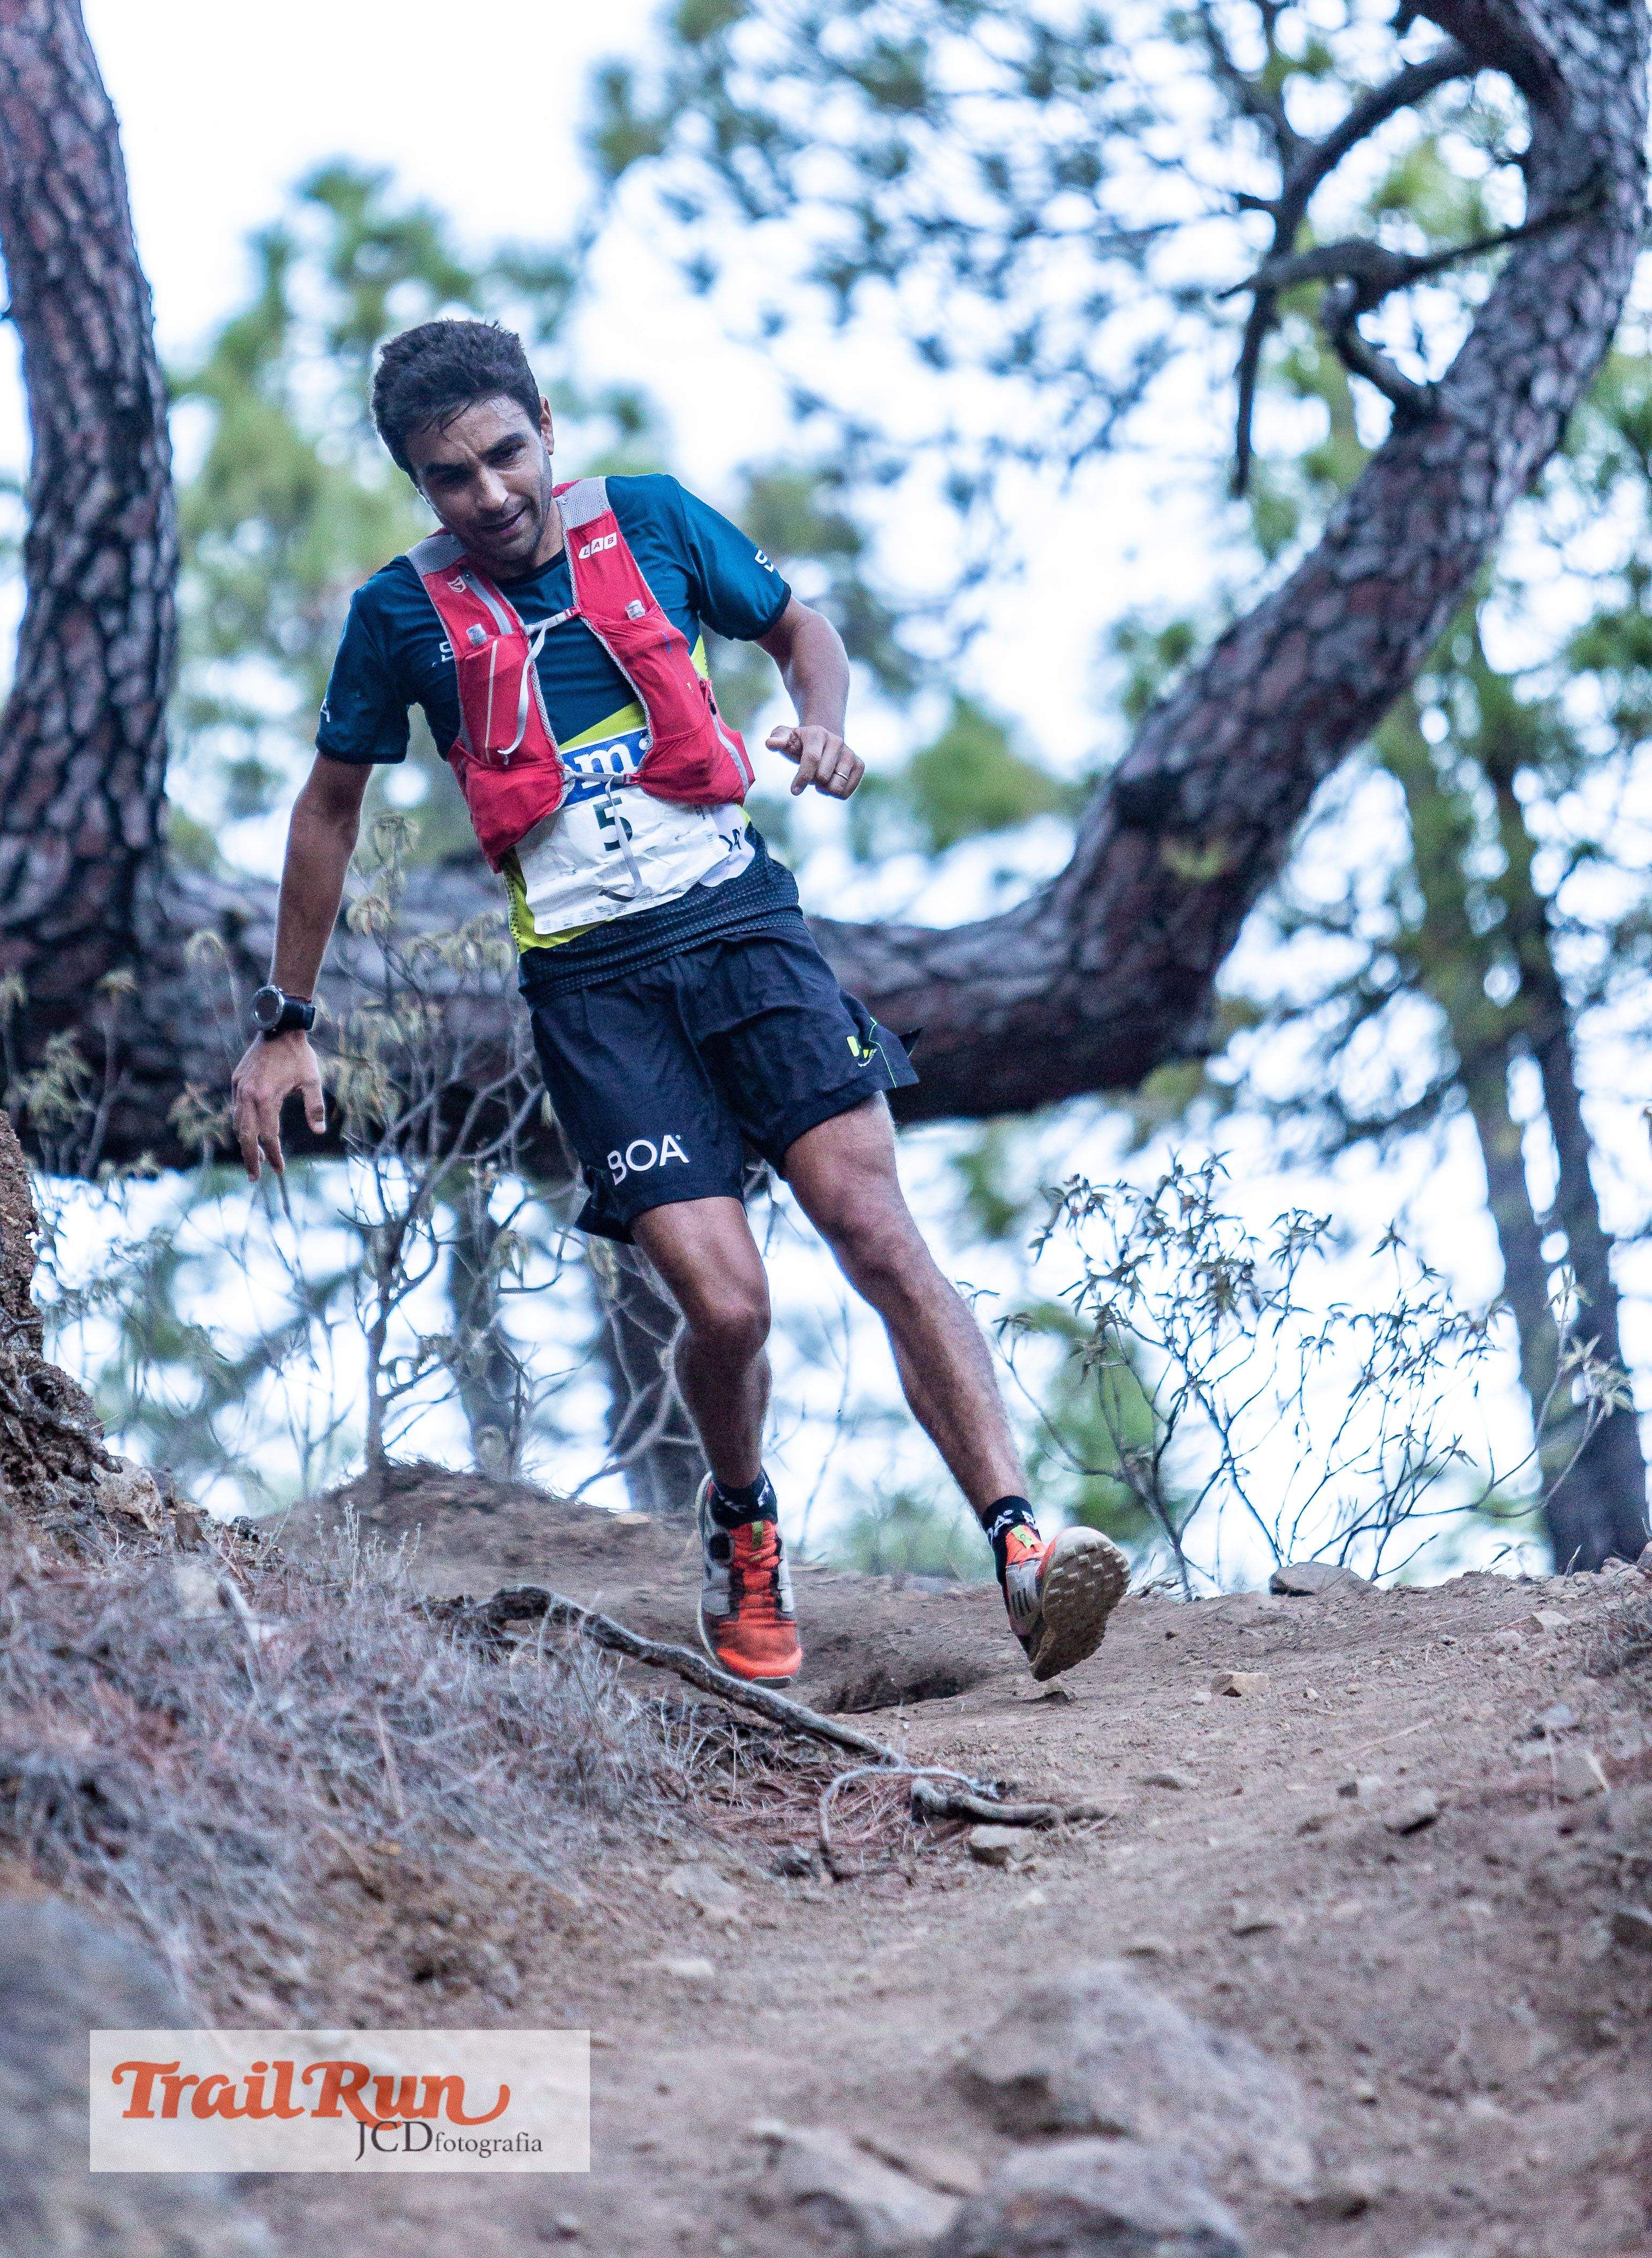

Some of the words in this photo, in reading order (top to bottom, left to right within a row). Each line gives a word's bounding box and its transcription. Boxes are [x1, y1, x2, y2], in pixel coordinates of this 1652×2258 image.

[578, 532, 617, 560] LAB
[593, 796, 633, 852] 5
[607, 1134, 690, 1185] BOA
